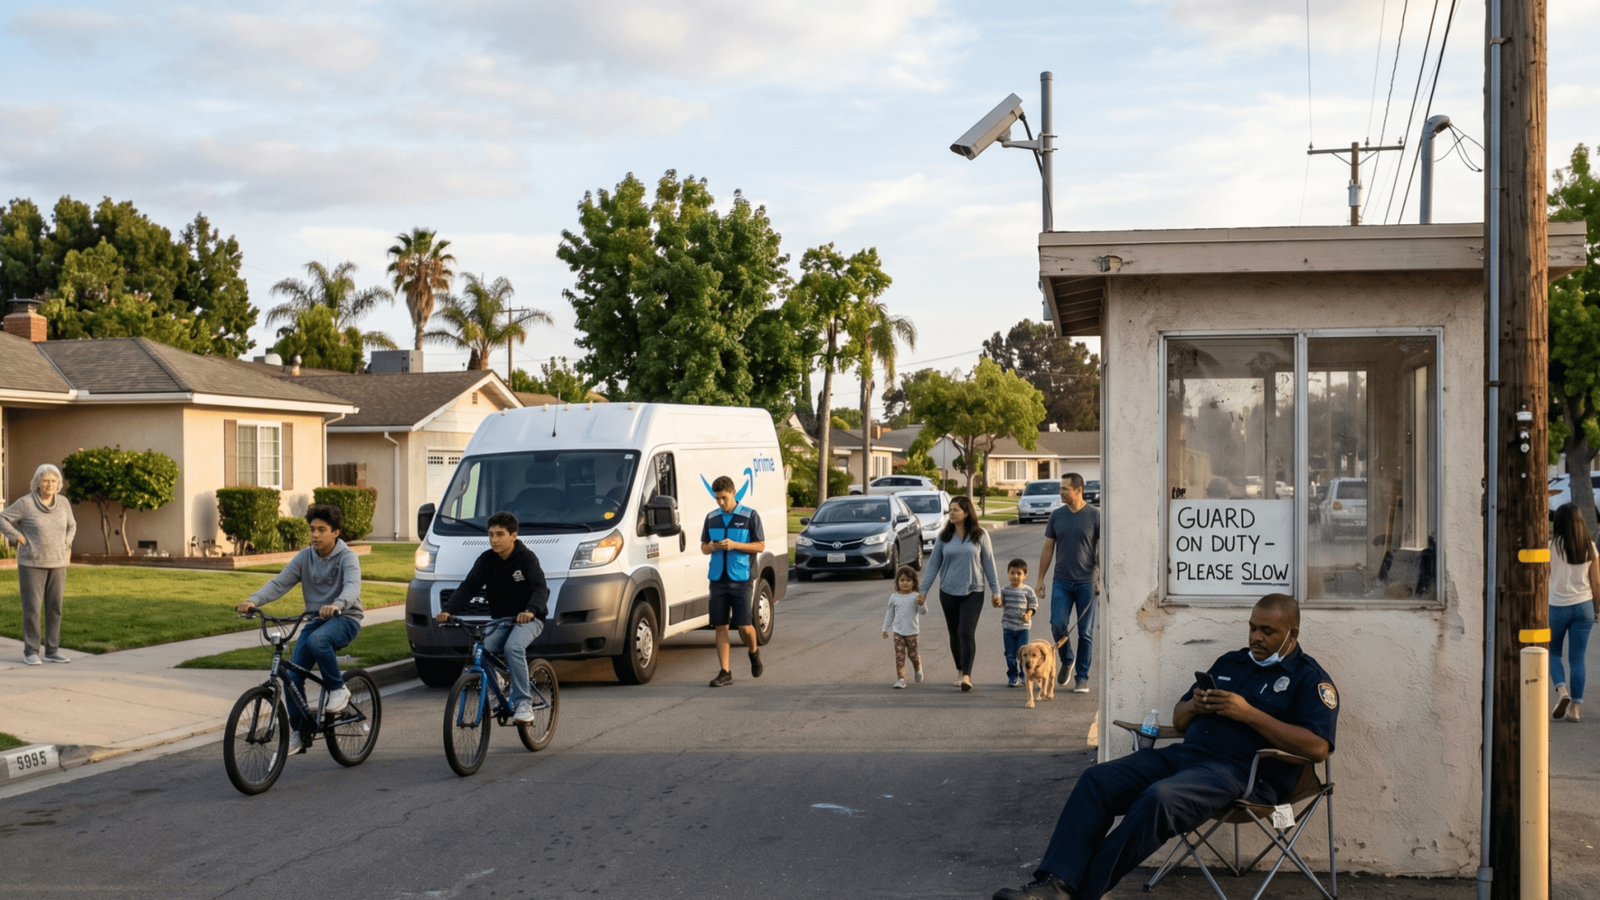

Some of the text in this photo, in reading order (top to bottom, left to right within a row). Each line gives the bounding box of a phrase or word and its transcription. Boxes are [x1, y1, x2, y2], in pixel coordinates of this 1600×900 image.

[753, 453, 775, 477] prime
[1177, 506, 1255, 529] GUARD
[1176, 535, 1202, 552] ON
[1176, 561, 1289, 581] PLEASE SLOW
[16, 750, 47, 771] 5995
